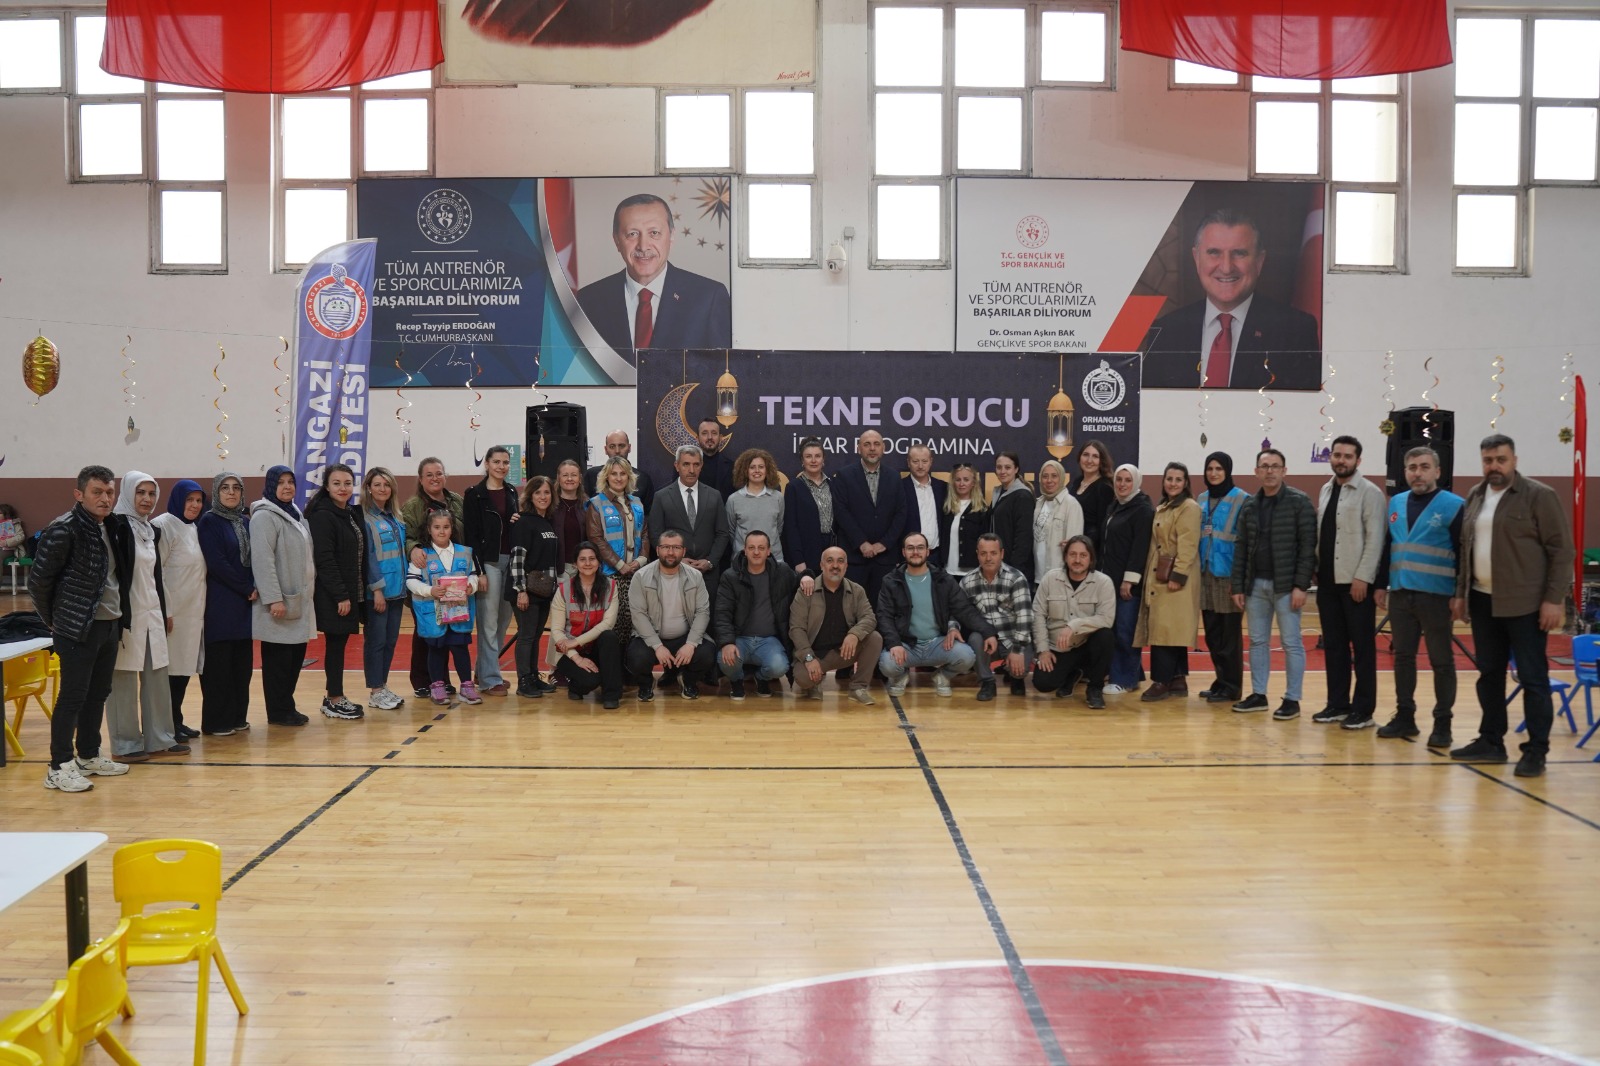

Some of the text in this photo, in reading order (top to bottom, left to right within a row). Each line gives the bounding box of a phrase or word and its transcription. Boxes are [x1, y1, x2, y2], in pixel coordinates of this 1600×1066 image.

[1017, 251, 1052, 260] GENÇLİK
[385, 259, 505, 275] TÜM ANTRENÖR
[1023, 260, 1065, 268] BAKANLIĞI
[391, 277, 523, 291] SPORCULARIMIZA
[983, 280, 1083, 294] TÜM ANTRENÖR
[373, 293, 520, 309] BAŞARILAR DİLİYORUM
[969, 294, 1096, 306] VE SPORCULARIMIZA
[973, 306, 1091, 319] BAŞARILAR DİLİYORUM
[396, 321, 496, 332] Recep Tayyip ERDOĞAN
[398, 333, 494, 343] T.C. CUMHURBAŞKANI
[1034, 329, 1056, 337] Aşkın
[1058, 329, 1075, 337] BAK
[1028, 340, 1051, 348] SPOR
[1054, 340, 1087, 348] BAKANI
[759, 395, 1031, 428] TEKNE ORUCU
[1082, 424, 1125, 432] BELEDİYESİ
[793, 432, 848, 454] İAR
